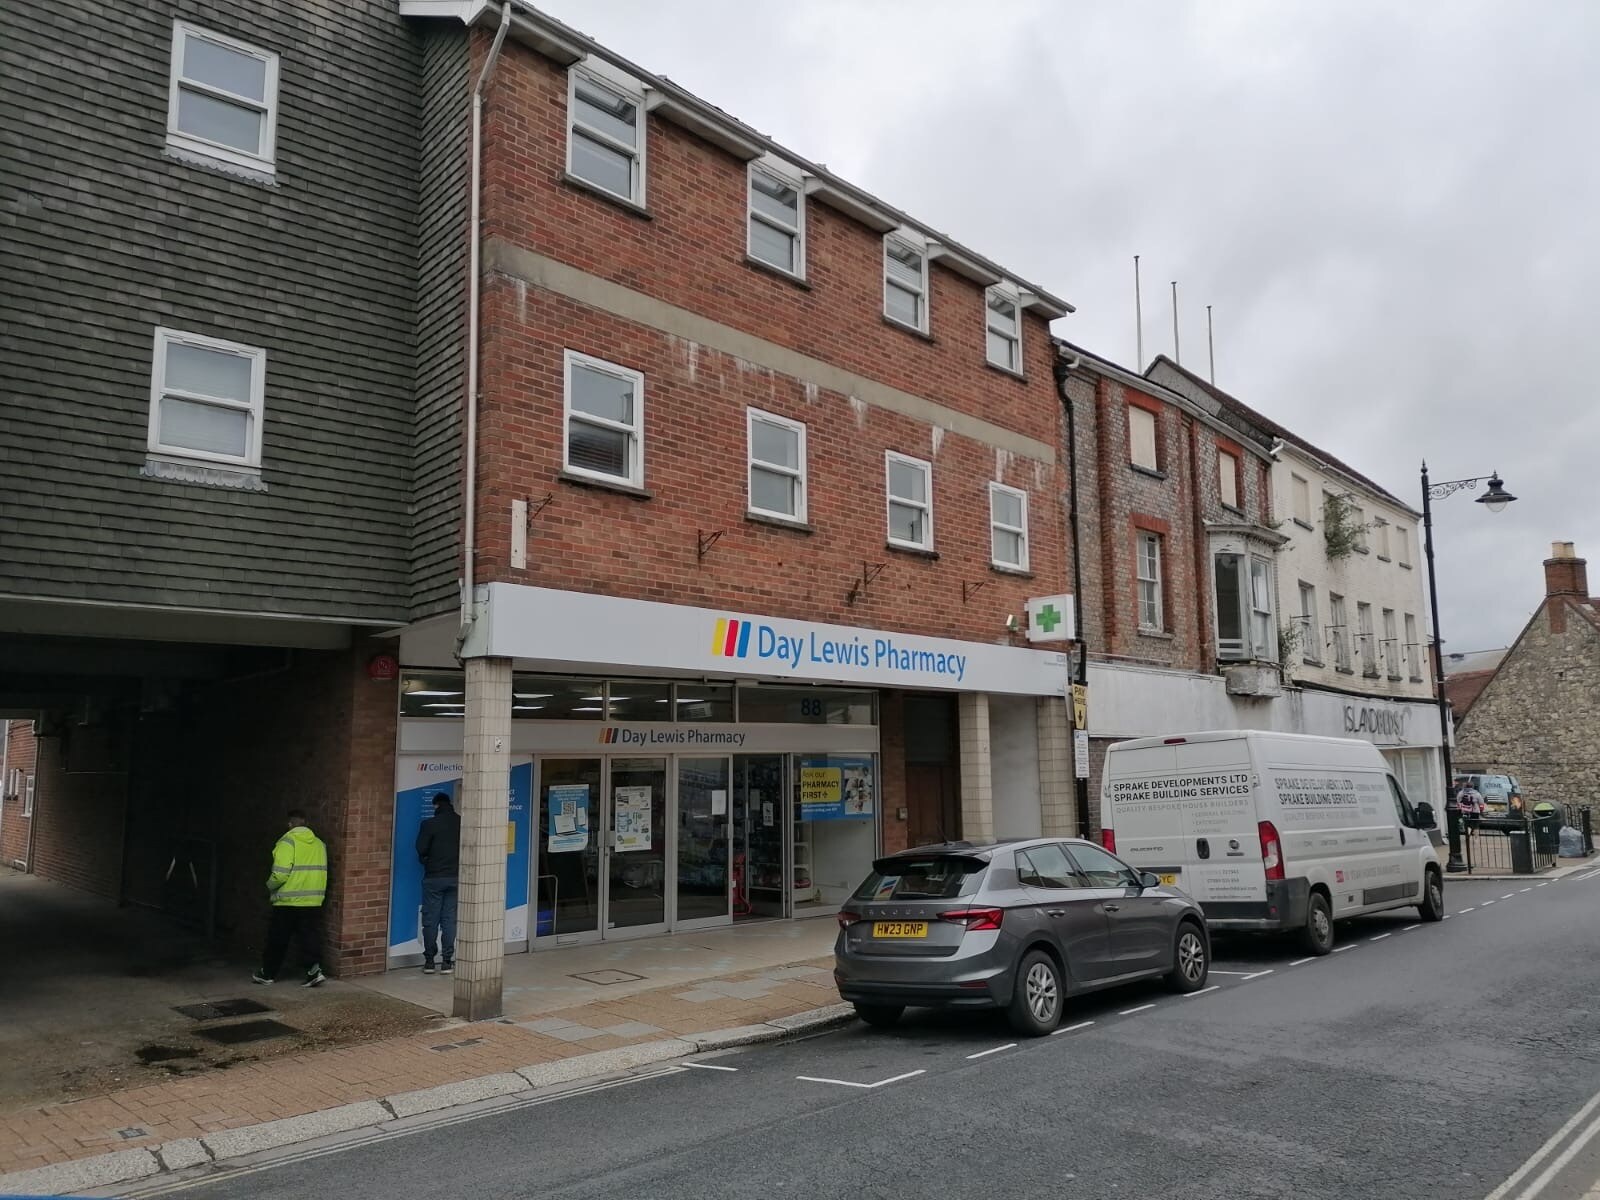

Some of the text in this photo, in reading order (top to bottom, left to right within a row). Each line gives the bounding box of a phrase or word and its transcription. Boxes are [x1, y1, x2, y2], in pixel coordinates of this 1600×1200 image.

[758, 625, 967, 683] Day Lewis Pharmacy
[1074, 686, 1085, 697] PAY
[801, 697, 821, 716] 88
[622, 729, 746, 747] Day Lewis Pharmacy
[802, 780, 839, 789] PHARMACY
[1113, 774, 1248, 792] SPRAKE DEVELOPMENTS LTD
[802, 791, 822, 799] FIRST
[1114, 784, 1249, 802] SPRAKE BUILDING SERVICES
[1278, 793, 1305, 805] SPRAKE
[1305, 793, 1332, 804] BUILDING
[1332, 793, 1358, 804] SERVICES
[877, 923, 923, 935] HW23 GNP
